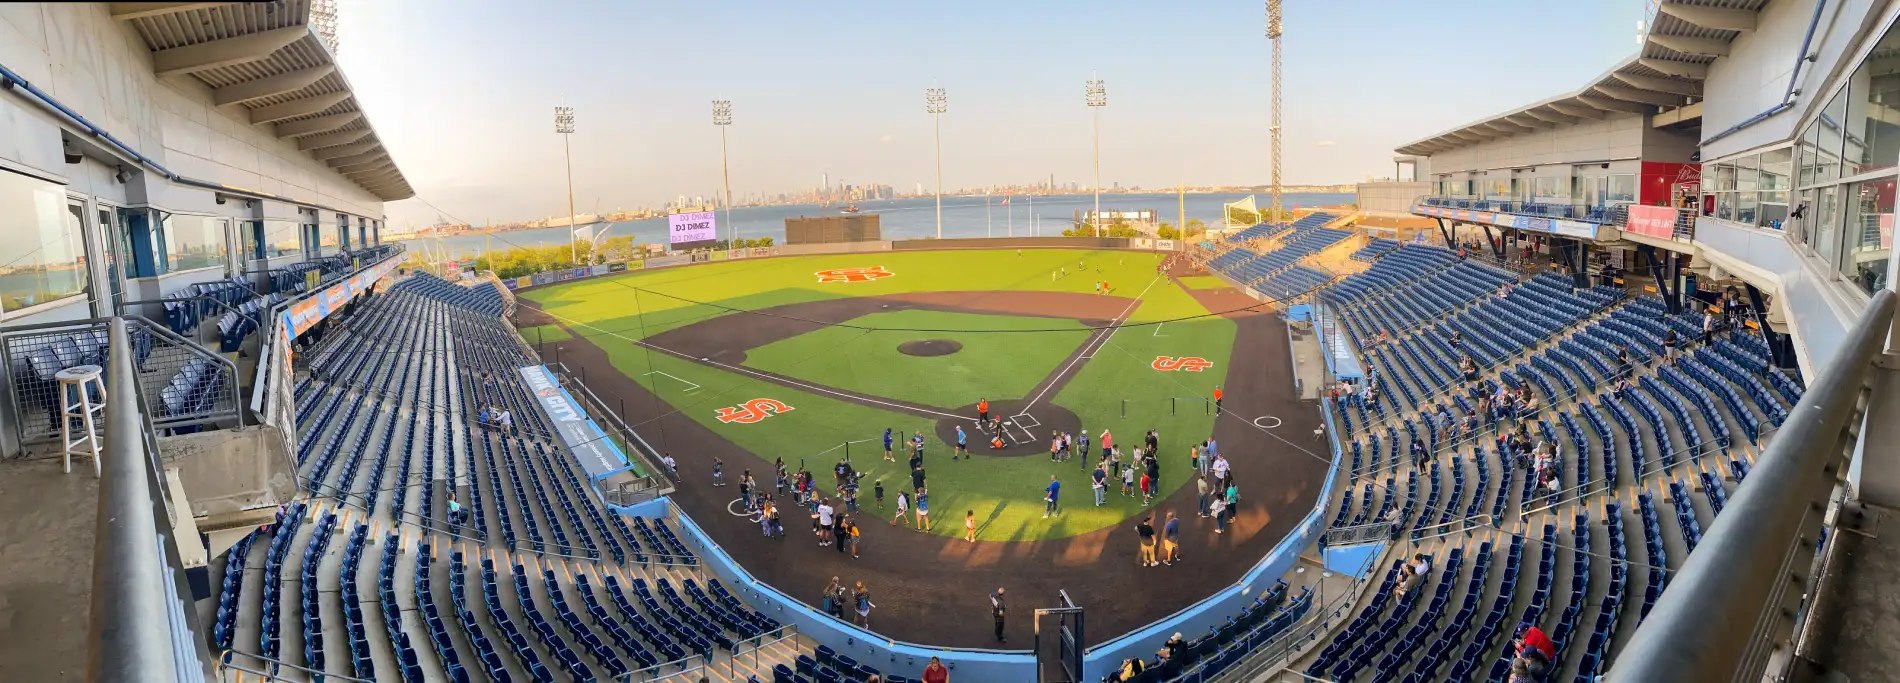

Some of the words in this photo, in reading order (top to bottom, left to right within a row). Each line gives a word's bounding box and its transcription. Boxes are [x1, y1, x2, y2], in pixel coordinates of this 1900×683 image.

[687, 222, 709, 230] DIMEZ
[683, 233, 705, 241] DIMEZ
[546, 396, 580, 420] CITY
